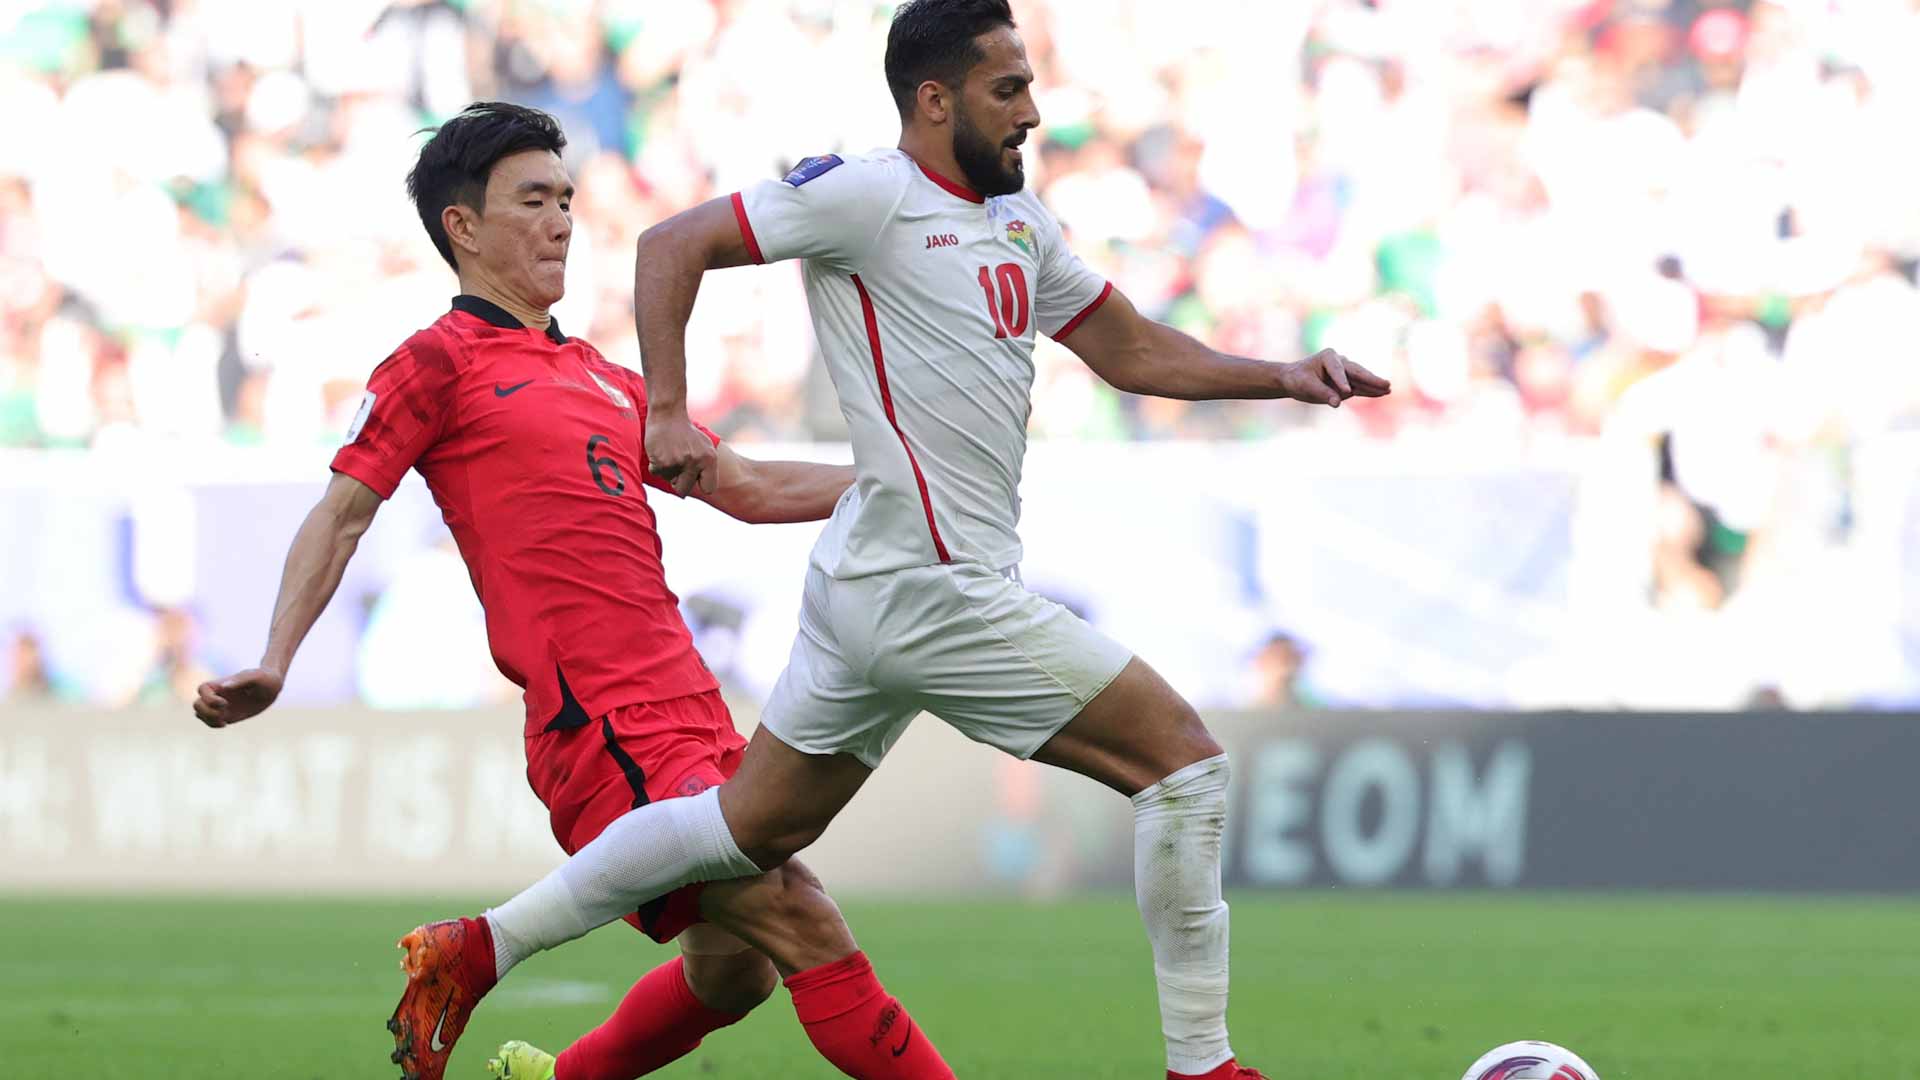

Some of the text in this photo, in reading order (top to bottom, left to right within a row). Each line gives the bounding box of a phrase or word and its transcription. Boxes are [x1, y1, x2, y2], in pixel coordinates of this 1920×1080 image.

[925, 233, 959, 249] JAKO
[978, 262, 1029, 339] 10
[586, 434, 625, 496] 6
[88, 736, 351, 861] WHAT
[1220, 741, 1533, 886] EOM
